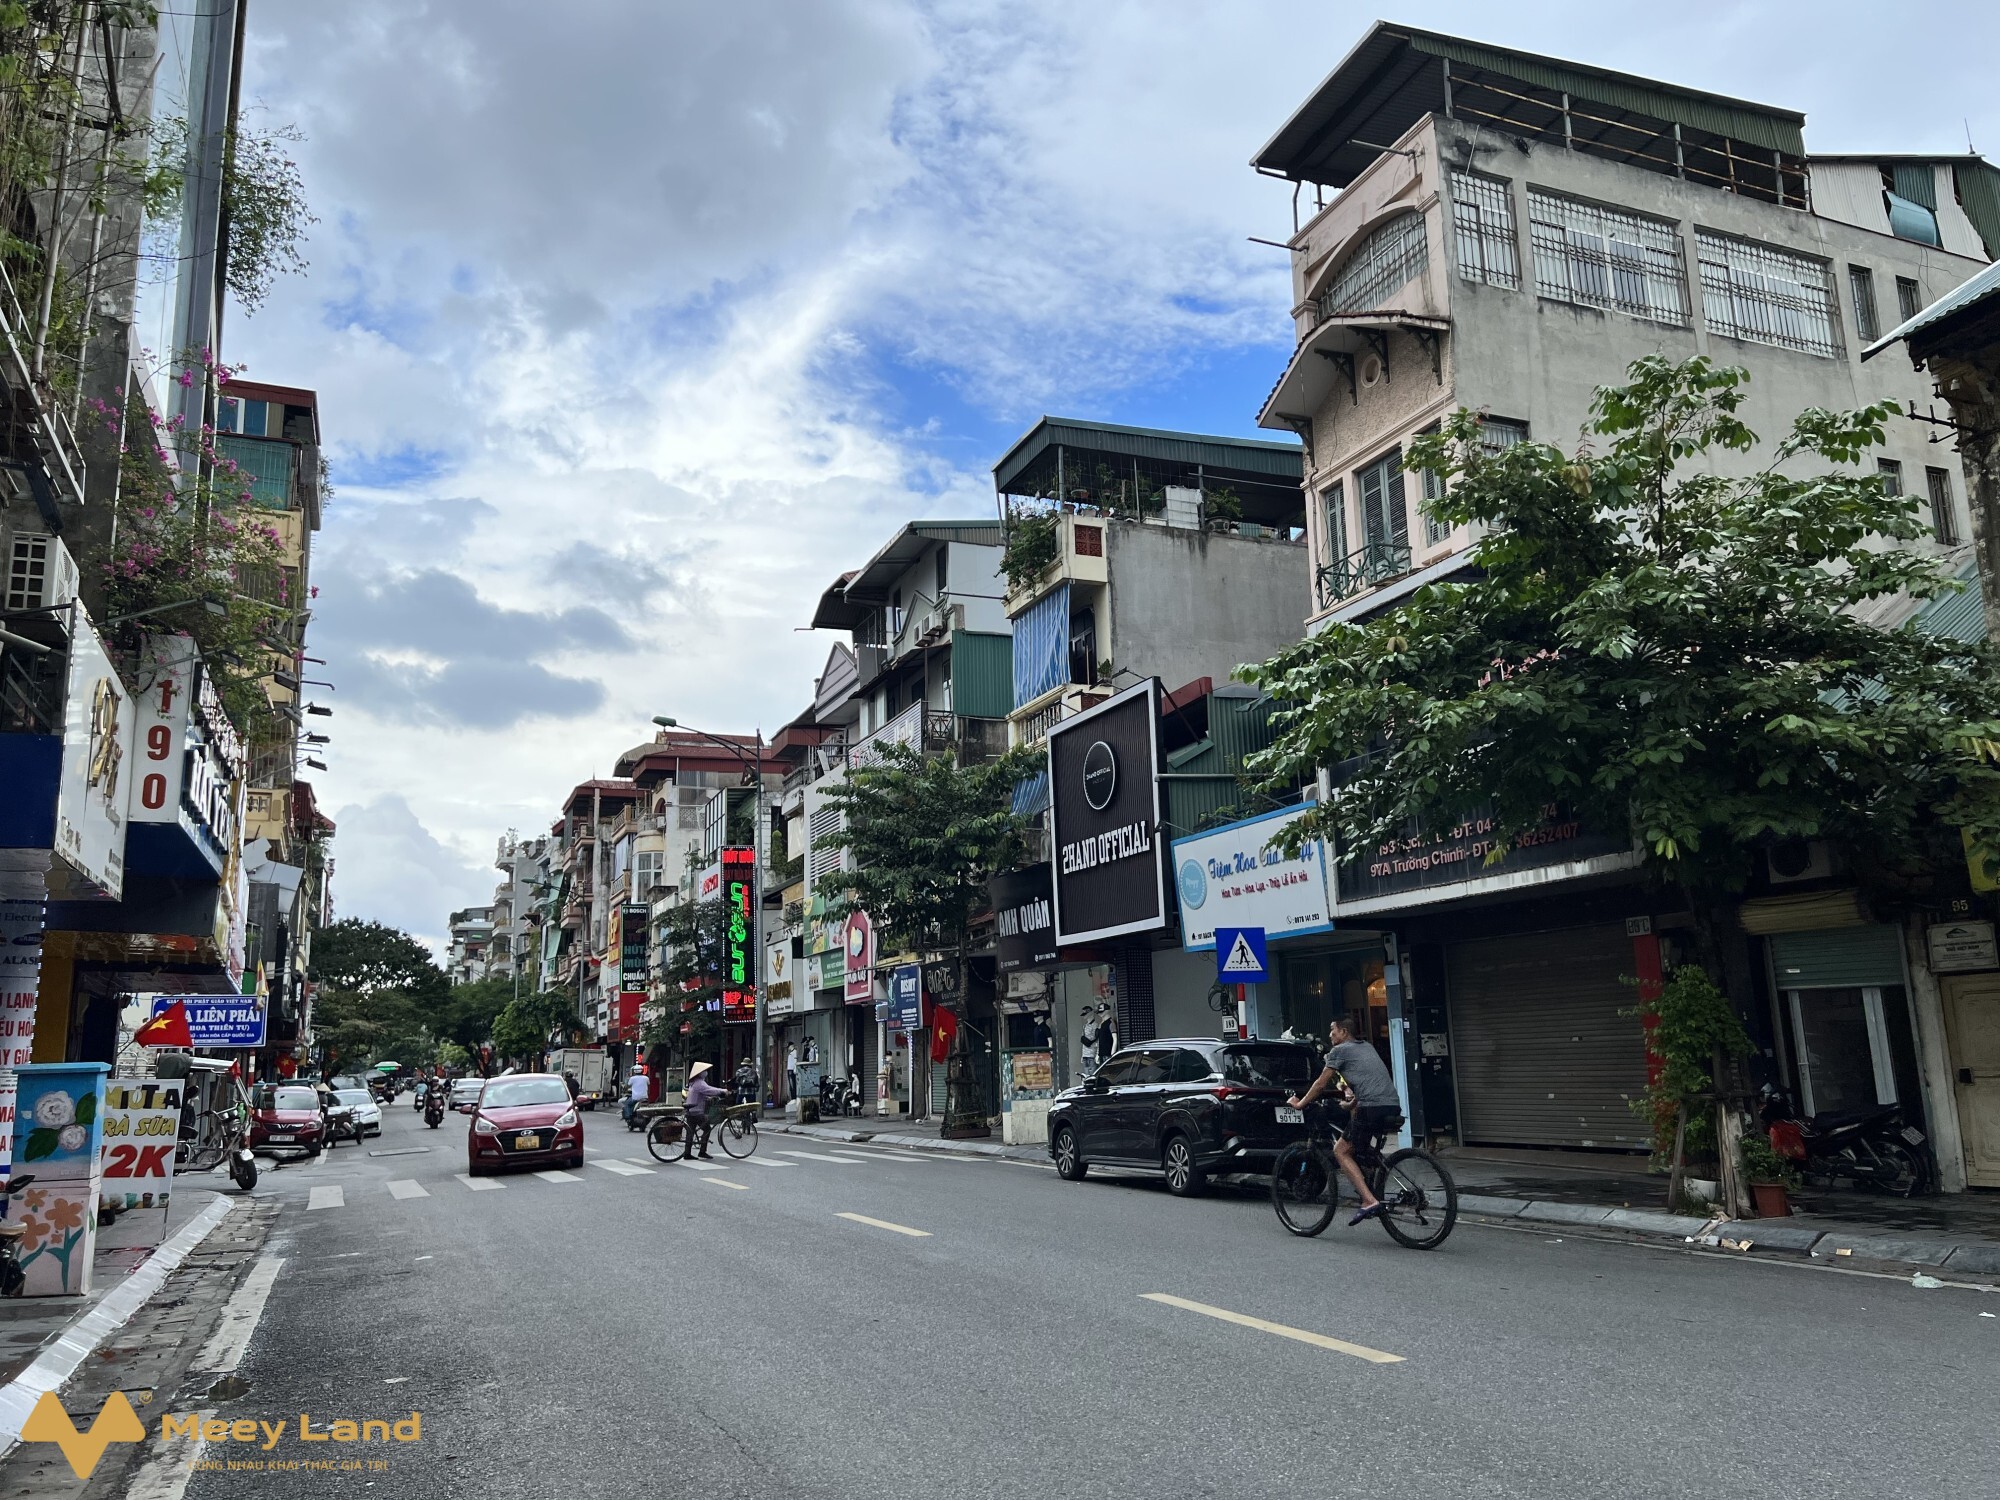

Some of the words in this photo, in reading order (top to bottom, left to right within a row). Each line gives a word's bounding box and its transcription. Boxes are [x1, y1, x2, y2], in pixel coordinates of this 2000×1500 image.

[142, 679, 176, 810] 190
[1062, 837, 1097, 875] 2HAND
[1098, 820, 1150, 864] OFFICIAL
[1370, 861, 1392, 878] 97A
[1516, 821, 1580, 849] 36252407
[1233, 851, 1258, 874] Hoa
[999, 907, 1019, 938] ANH
[1020, 896, 1051, 934] QUÂN
[1951, 900, 1969, 912] 95
[196, 1006, 227, 1022] LIÊN
[209, 1023, 234, 1031] THIÊN
[103, 1114, 130, 1137] RÀ
[134, 1115, 176, 1137] SỮA
